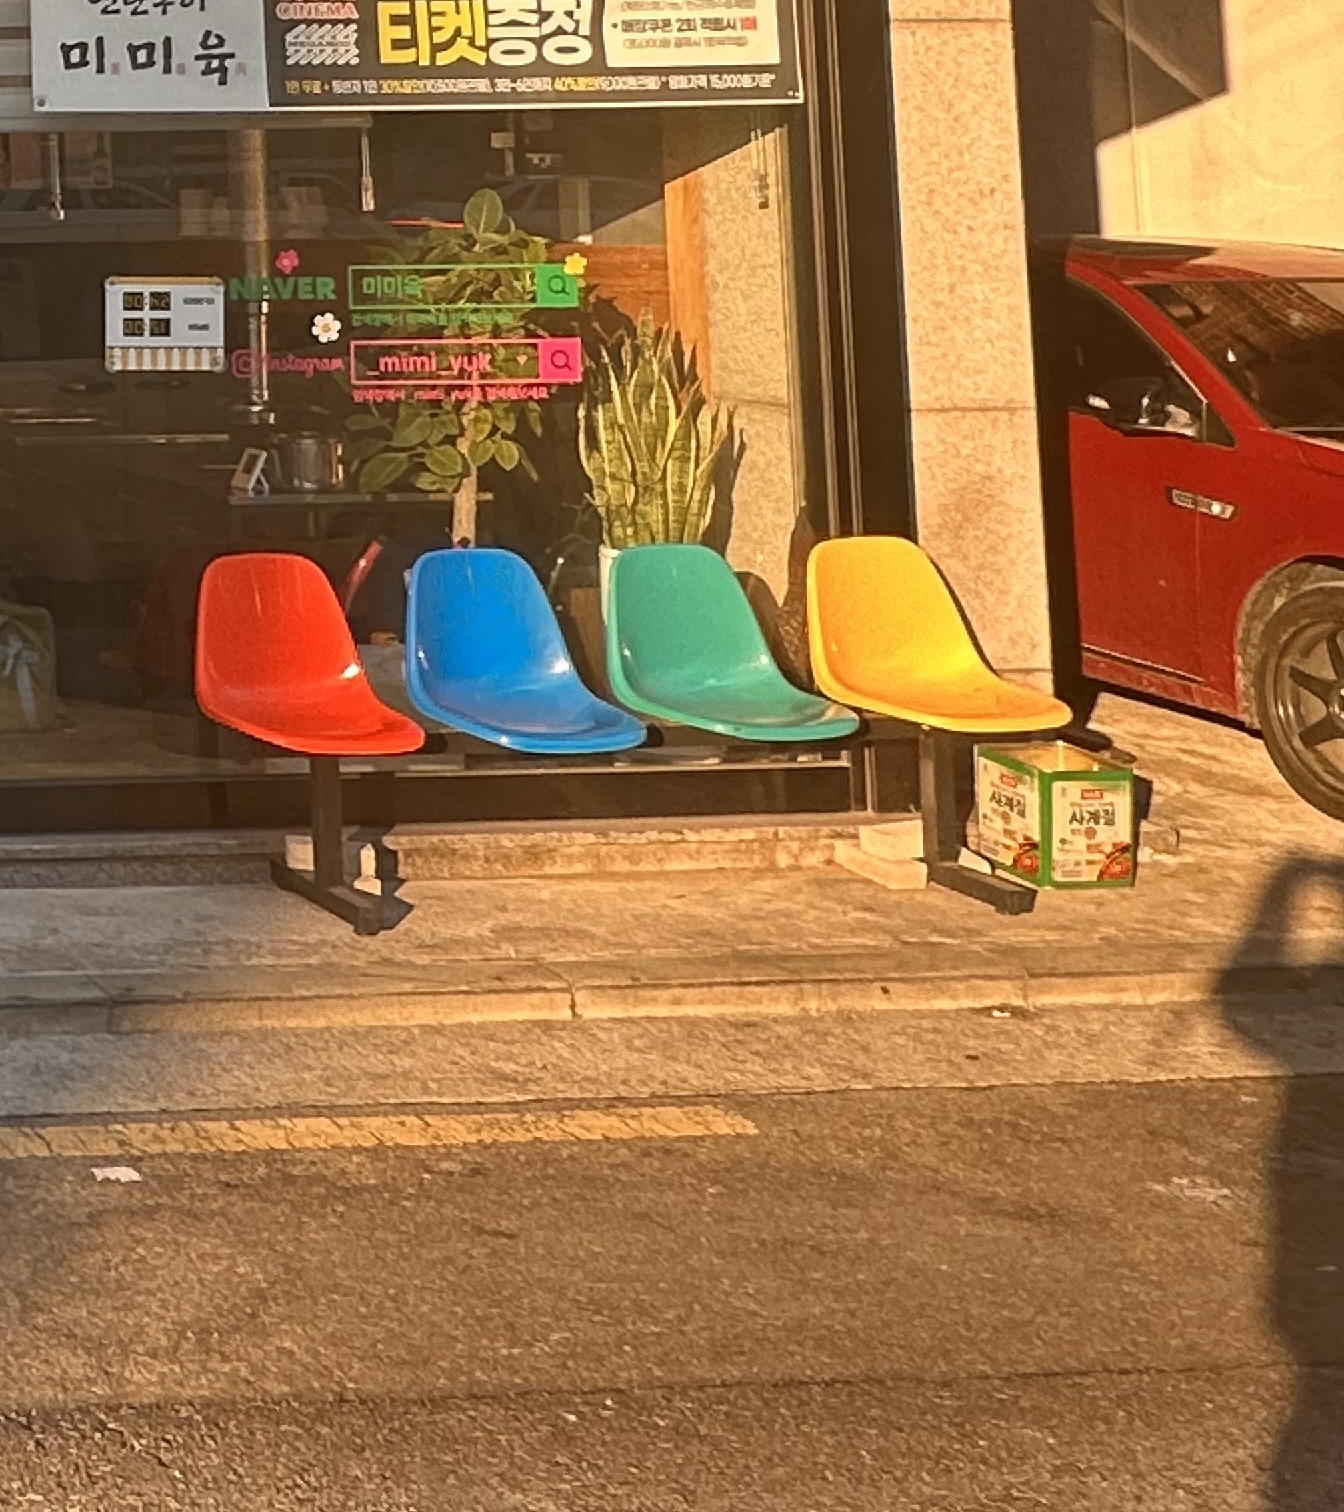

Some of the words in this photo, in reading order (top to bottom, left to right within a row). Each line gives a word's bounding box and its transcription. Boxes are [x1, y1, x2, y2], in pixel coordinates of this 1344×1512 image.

[276, 2, 359, 19] CINEMA
[194, 29, 235, 86] 육
[229, 277, 337, 300] NAVER
[362, 270, 423, 299] 미미육
[366, 349, 493, 378] _mimi_yuk
